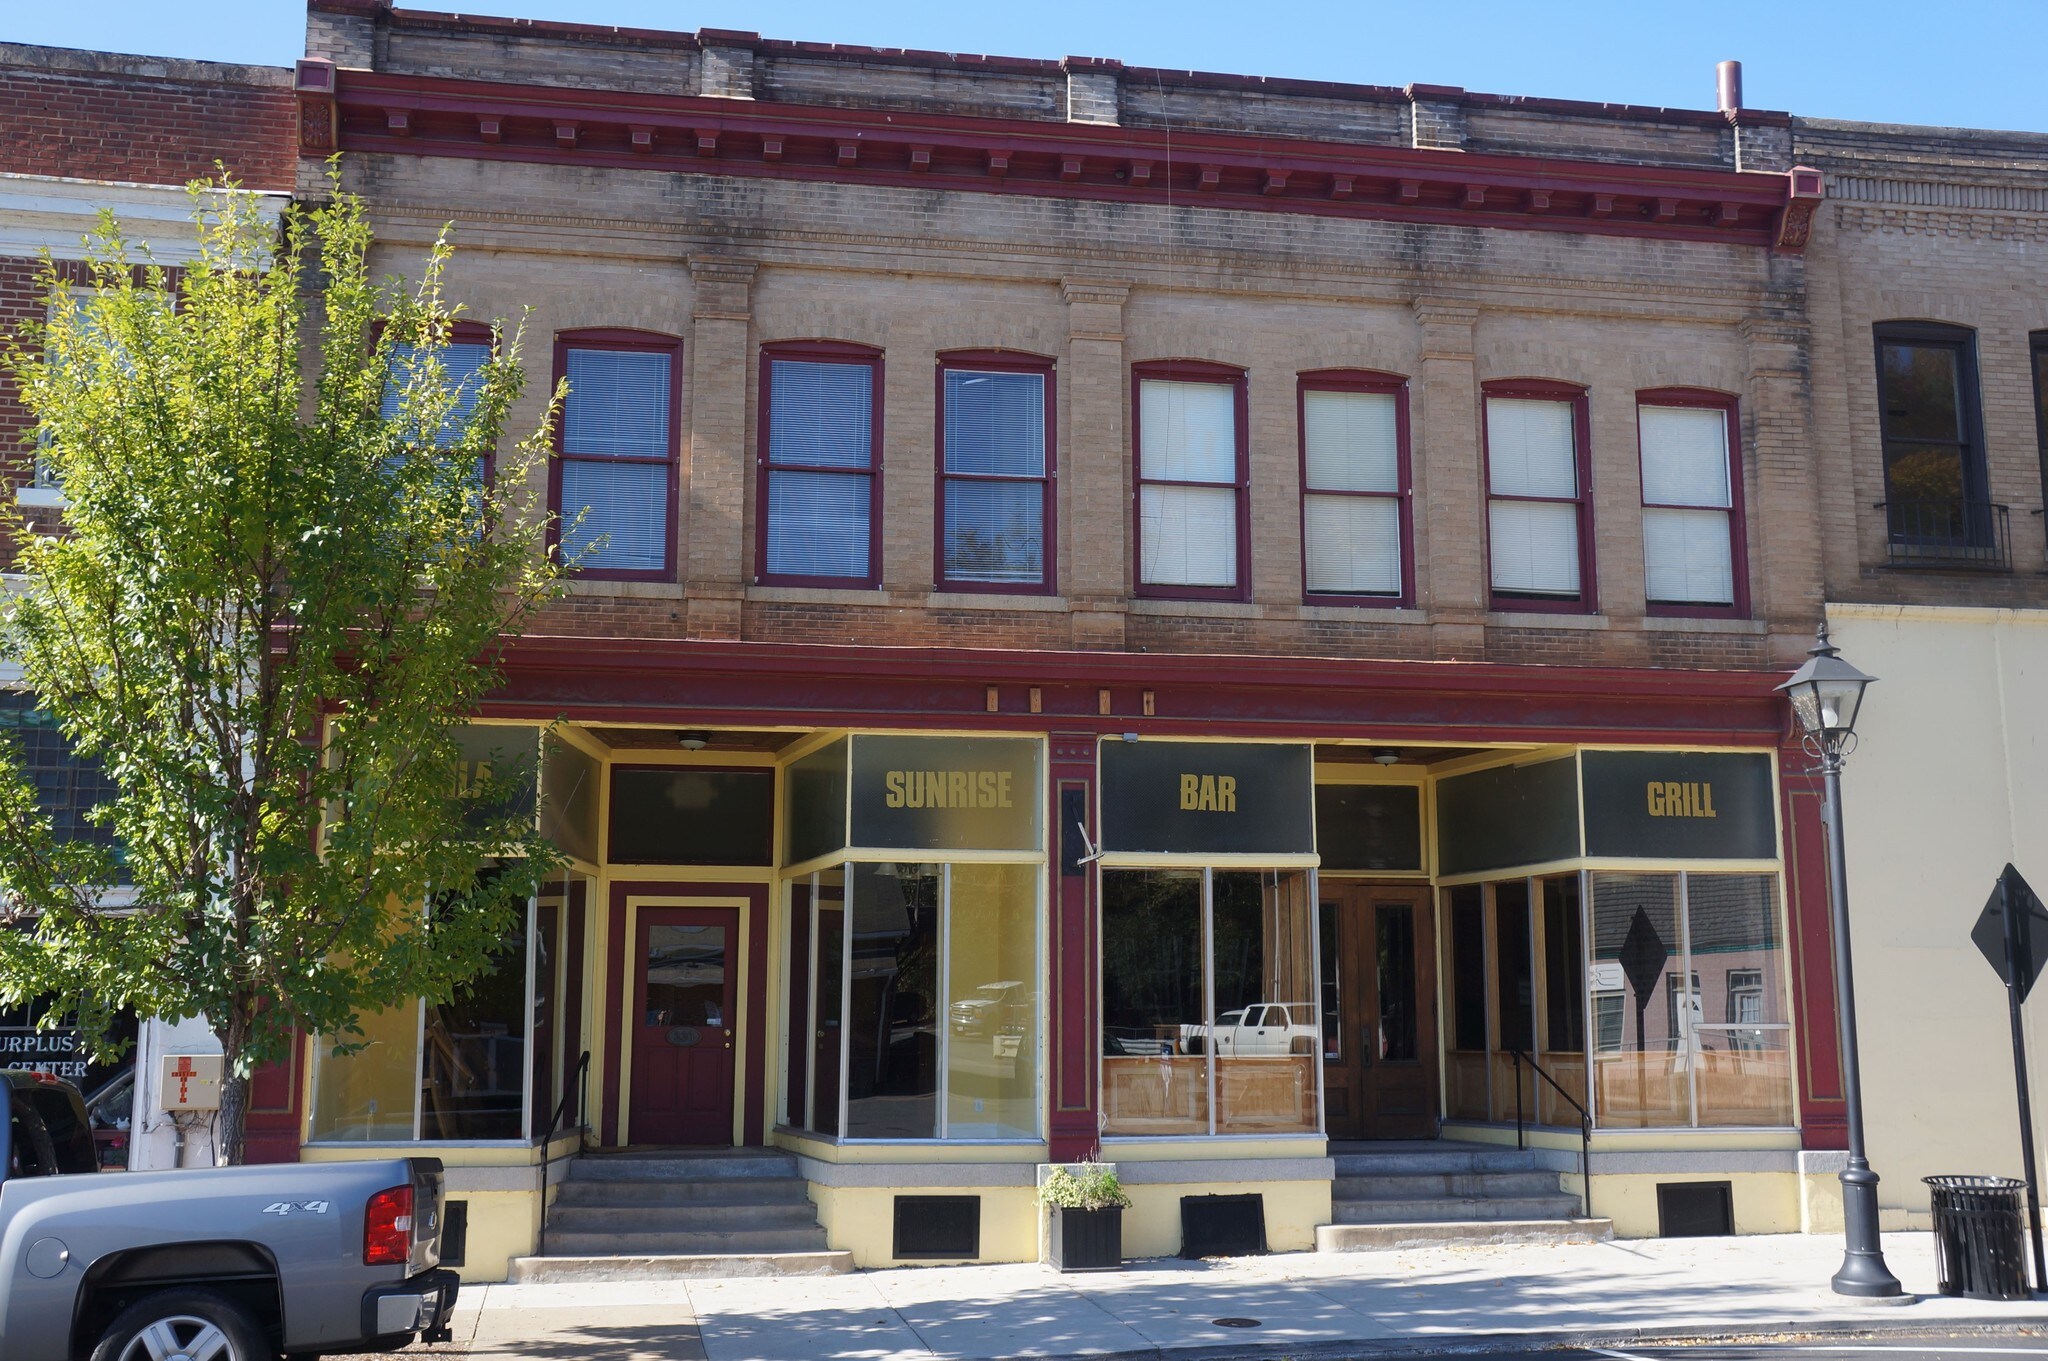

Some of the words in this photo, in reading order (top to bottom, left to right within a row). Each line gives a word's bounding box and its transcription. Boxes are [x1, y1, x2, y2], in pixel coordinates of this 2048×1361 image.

[886, 770, 1013, 808] SUNRISE
[1180, 773, 1236, 812] BAR
[1647, 781, 1717, 817] GRILL
